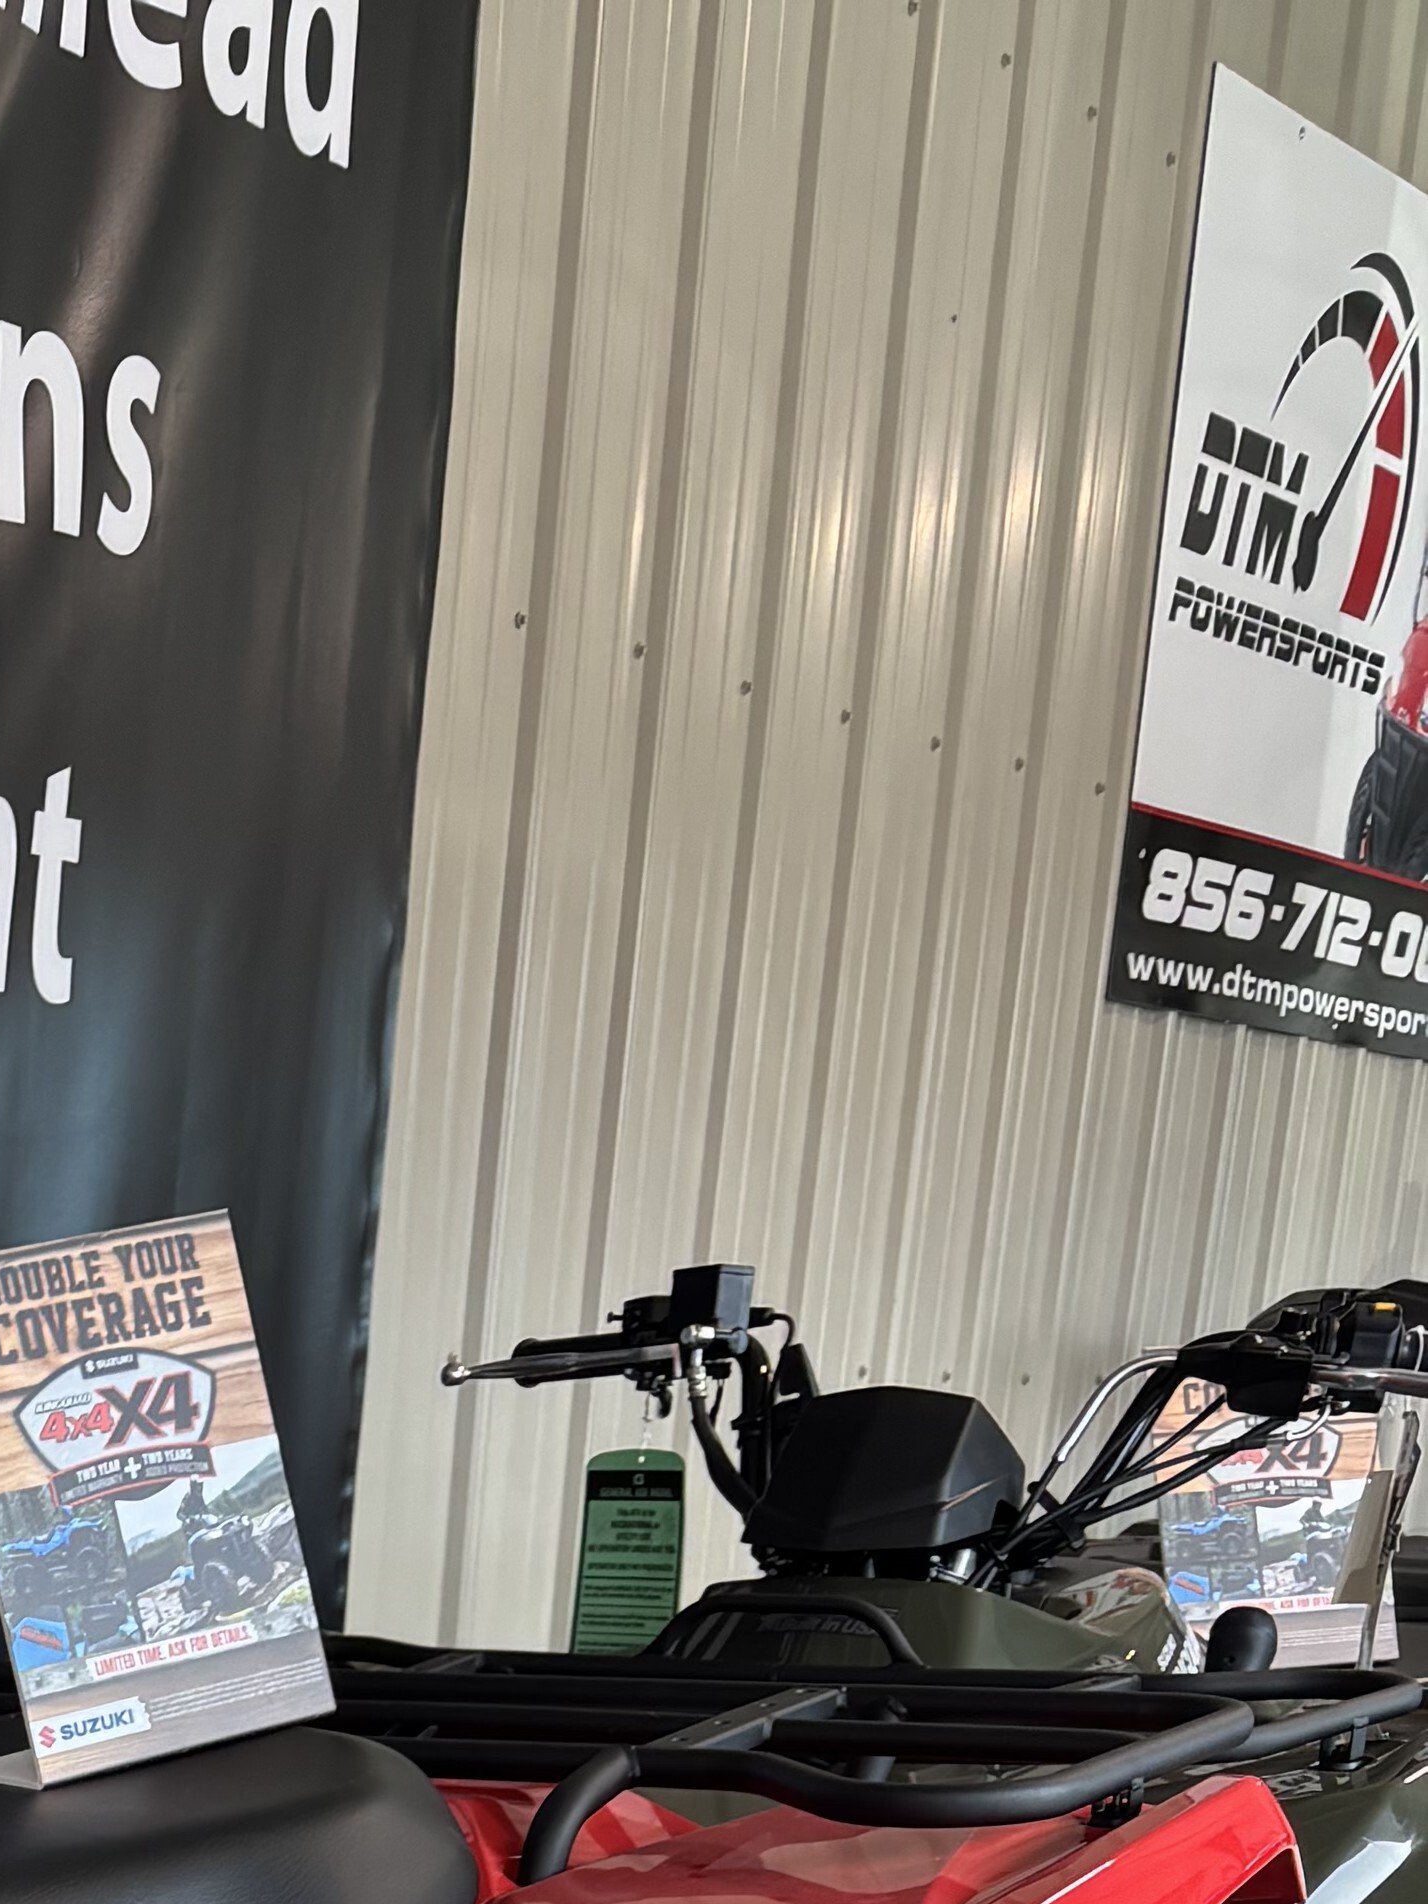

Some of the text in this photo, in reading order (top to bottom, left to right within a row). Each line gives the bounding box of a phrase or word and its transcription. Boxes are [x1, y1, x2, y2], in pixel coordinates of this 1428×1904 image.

[1180, 411, 1310, 586] DTM
[1168, 576, 1386, 695] POWERSPORTS
[1126, 952, 1428, 1038] www.dtmpowerspor
[117, 1232, 201, 1284] YOUR
[94, 1370, 202, 1450] X4
[93, 1654, 136, 1677] LIMITED
[168, 1641, 188, 1659] ASK
[190, 1636, 209, 1653] FOR
[59, 1708, 135, 1741] SUZUKI
